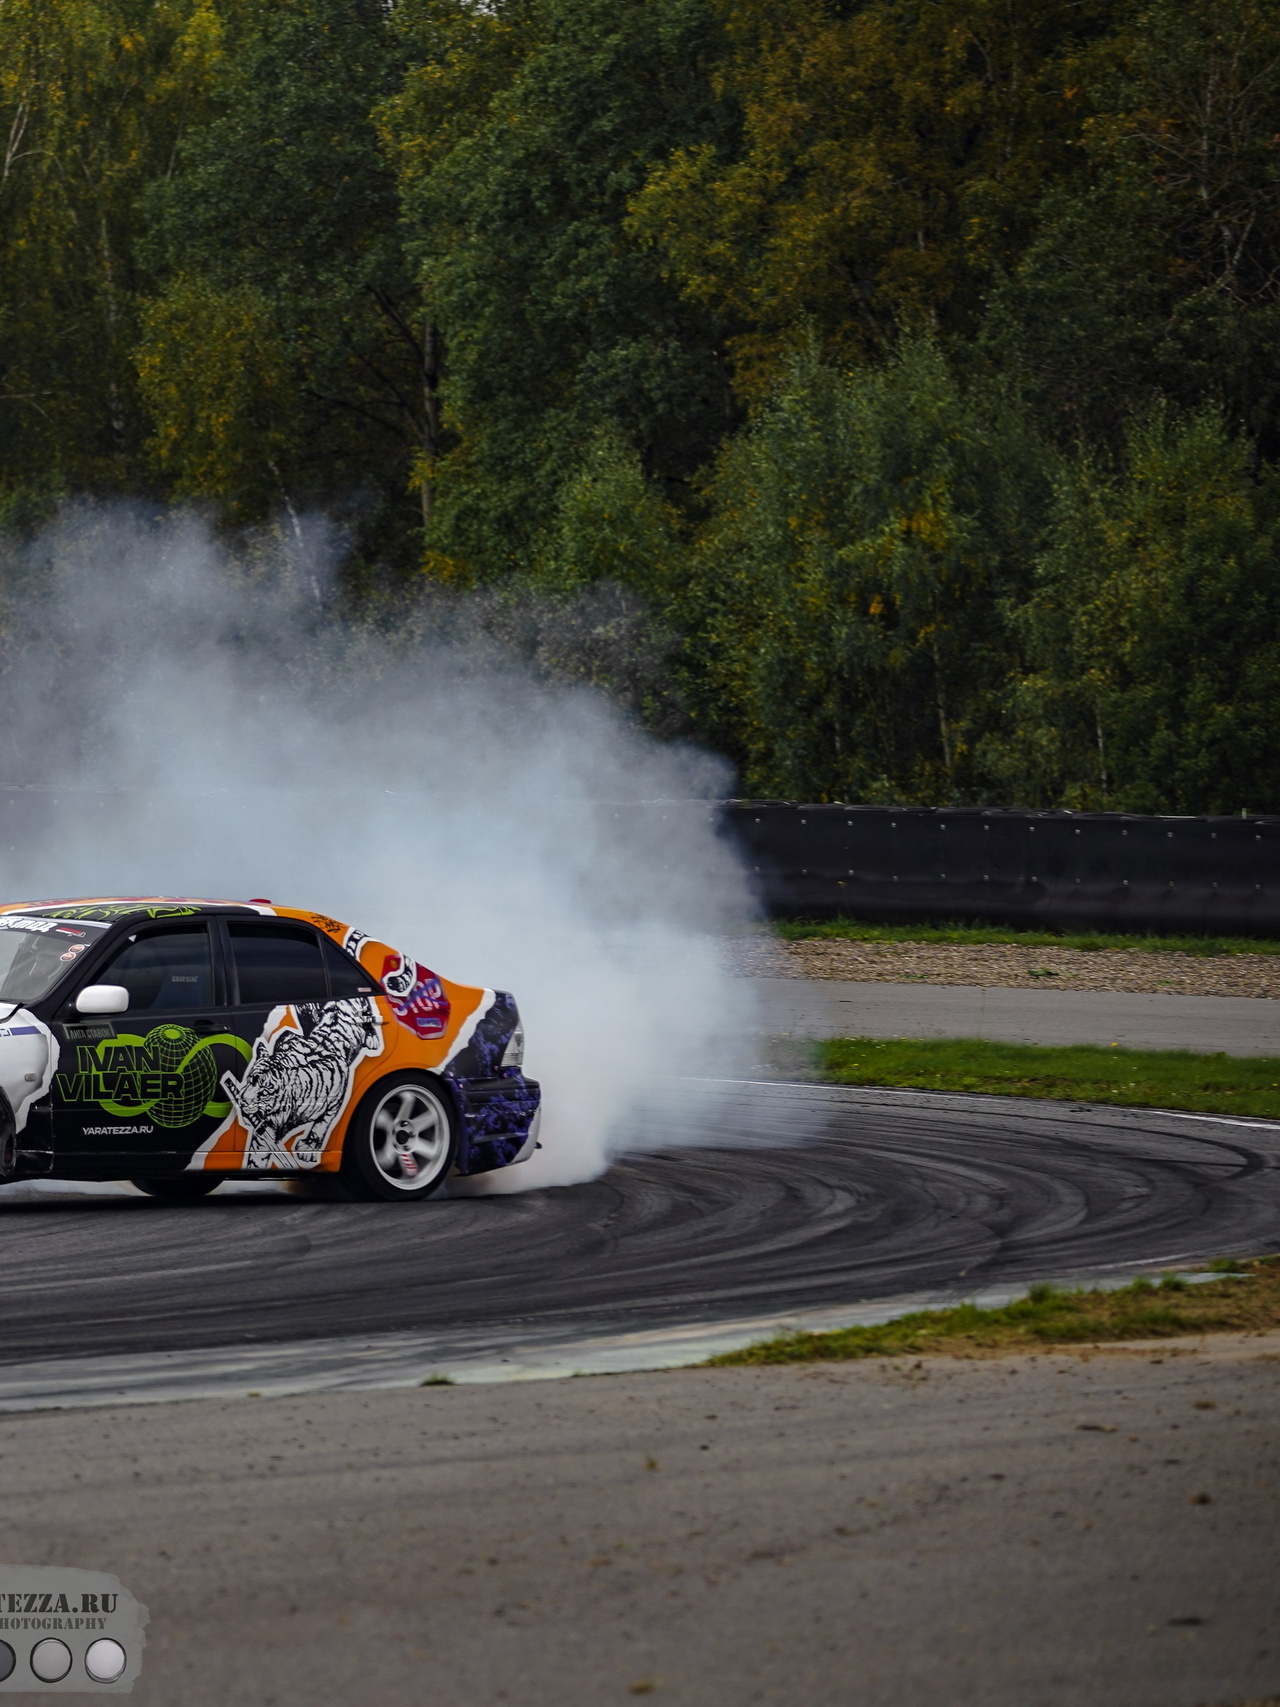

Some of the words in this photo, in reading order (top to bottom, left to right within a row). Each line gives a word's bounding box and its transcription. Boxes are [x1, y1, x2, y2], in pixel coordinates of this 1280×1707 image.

[76, 1044, 161, 1074] IVAN
[55, 1072, 185, 1102] VILAER
[82, 1125, 154, 1136] YARATEZZA.RU
